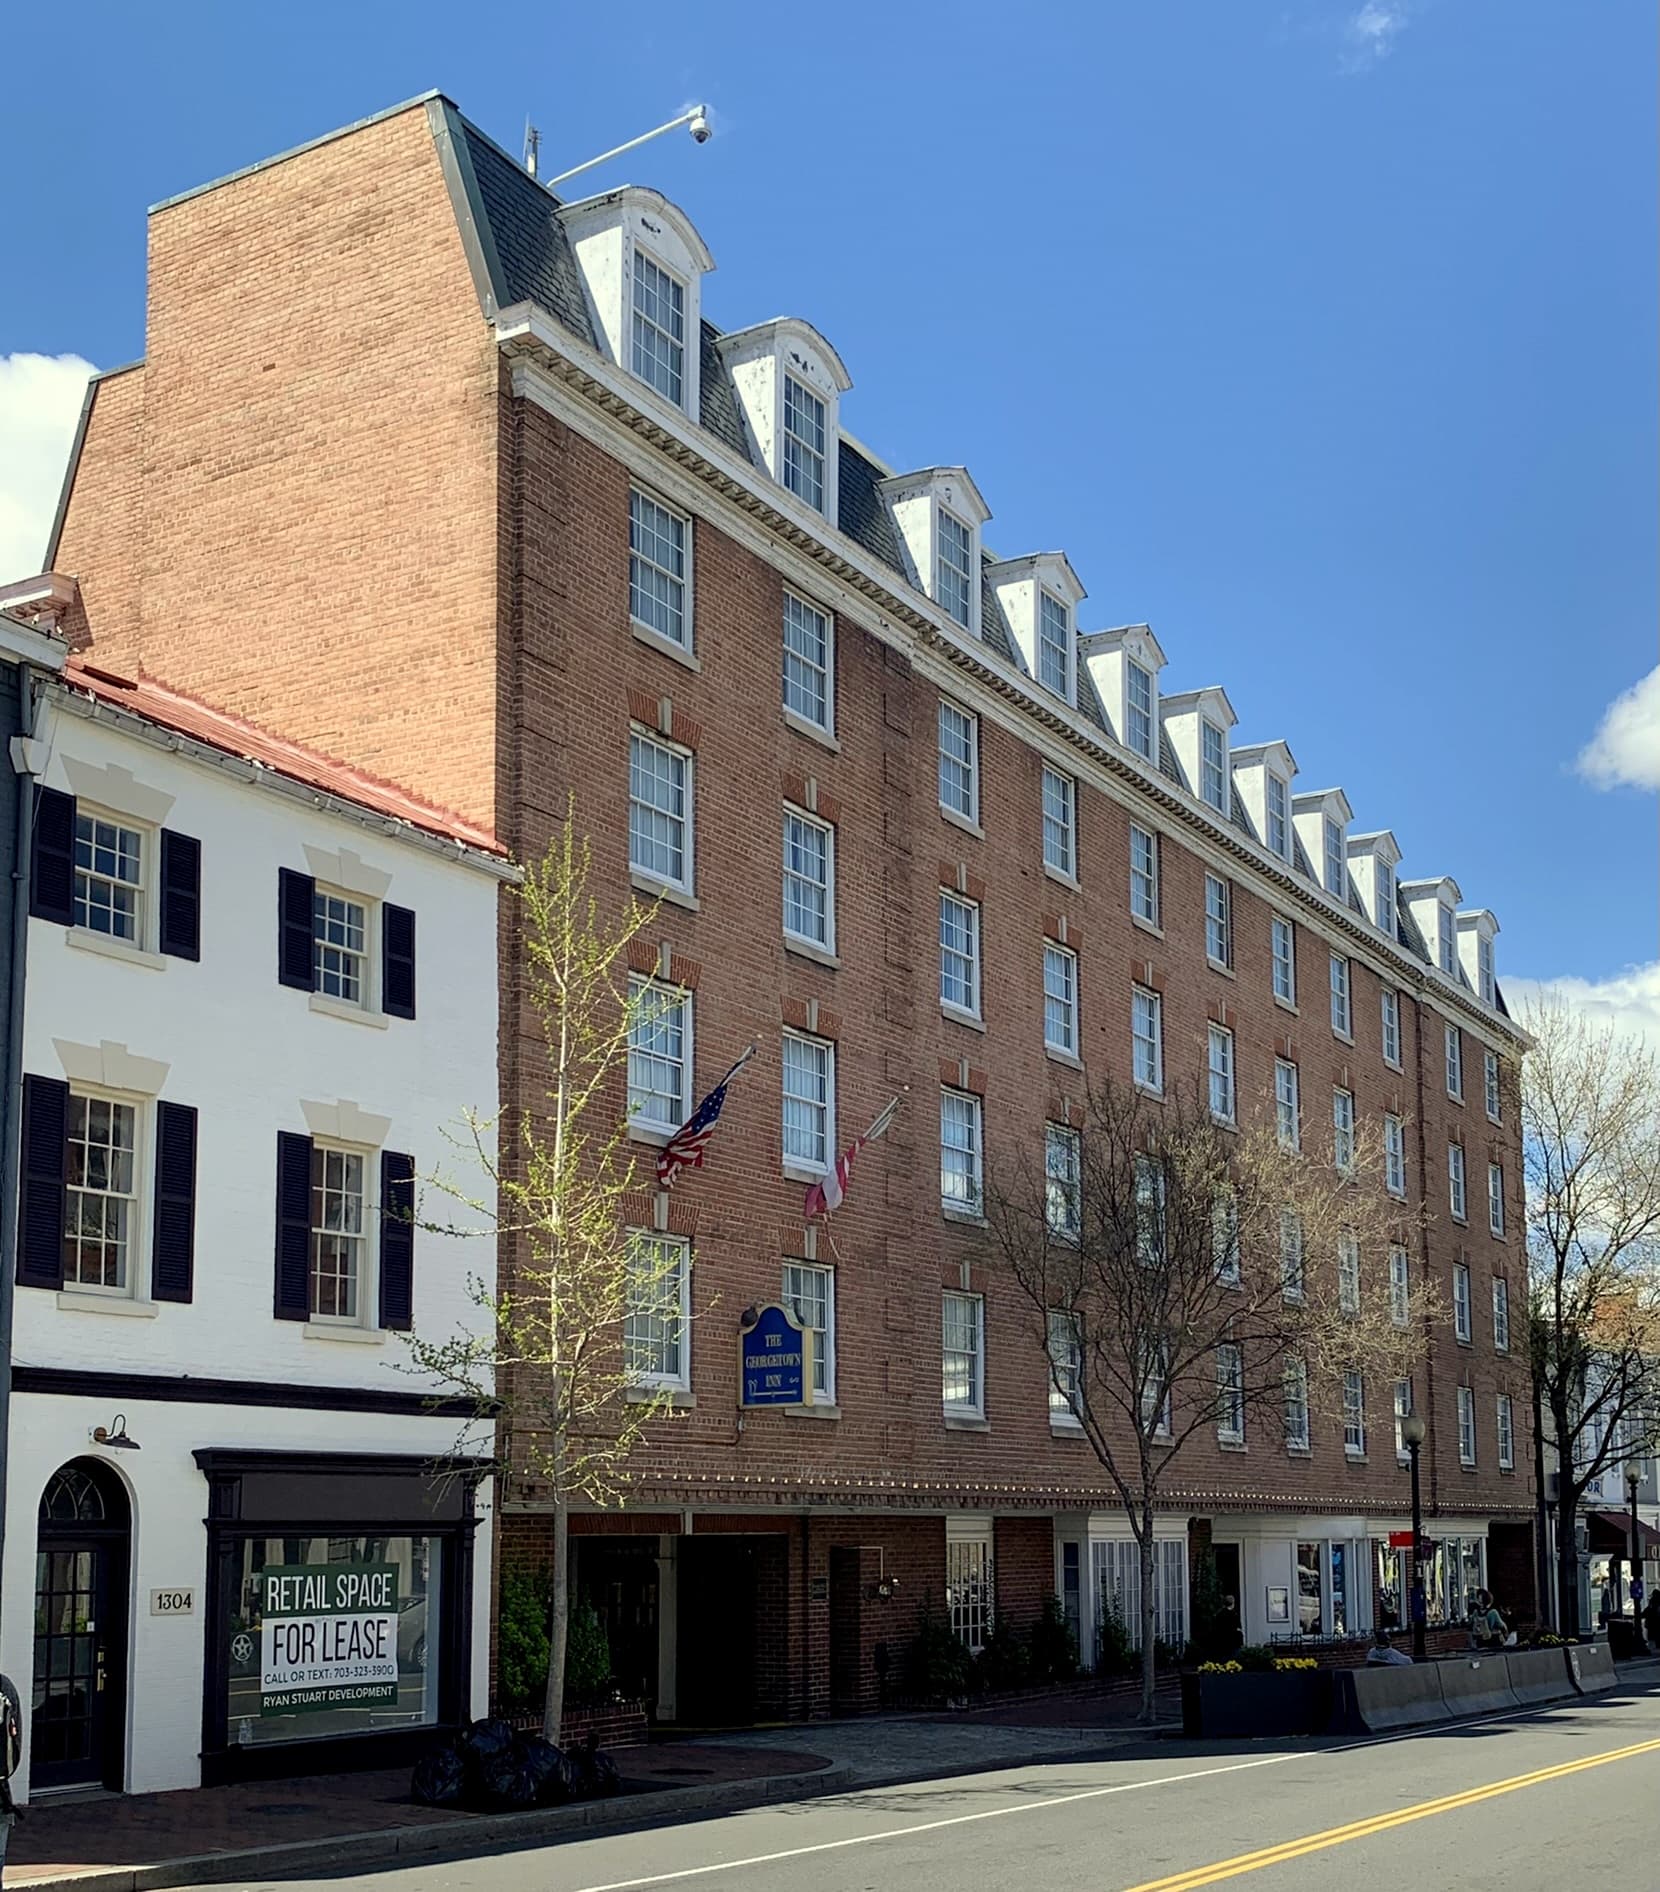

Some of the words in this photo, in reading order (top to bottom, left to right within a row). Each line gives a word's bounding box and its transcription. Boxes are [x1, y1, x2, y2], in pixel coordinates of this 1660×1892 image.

[765, 1334, 782, 1347] THE
[745, 1353, 801, 1368] GEORGETOWN
[765, 1375, 782, 1387] INN
[157, 1593, 192, 1609] 1304
[267, 1574, 332, 1612] RETAIL
[336, 1573, 393, 1609] SPACE
[273, 1622, 316, 1667] FOR
[322, 1619, 388, 1662] LEASE
[264, 1672, 289, 1685] CALL
[290, 1671, 305, 1682] OR
[307, 1668, 333, 1680] TEXT:
[334, 1664, 394, 1678] 703-323-3900
[263, 1695, 290, 1708] RYAN
[291, 1690, 328, 1704] STUART
[328, 1686, 394, 1701] DEVELOPMENT
